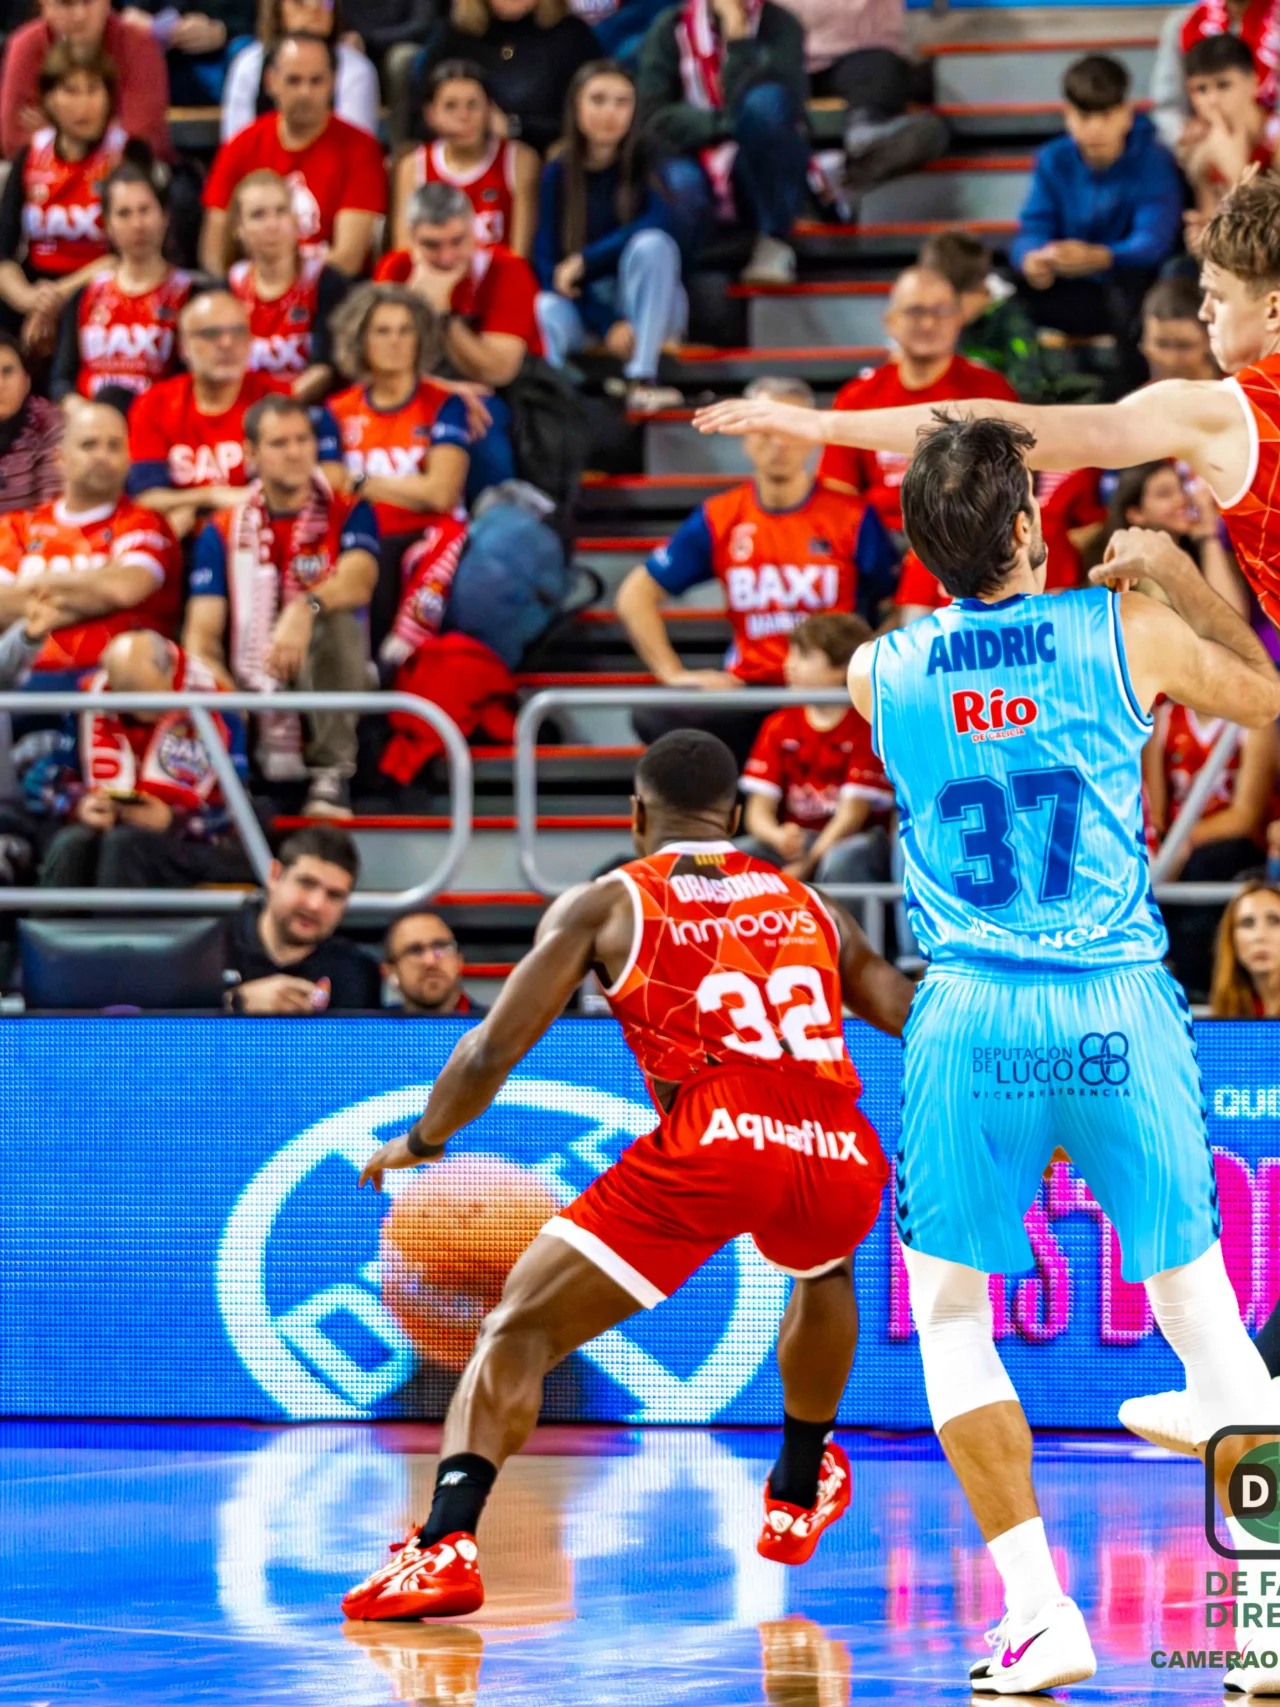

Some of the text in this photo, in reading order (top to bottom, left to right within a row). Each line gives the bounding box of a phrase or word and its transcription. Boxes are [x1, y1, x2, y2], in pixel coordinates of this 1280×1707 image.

[727, 564, 839, 611] BAXI
[926, 622, 1057, 676] ANDRIC
[952, 689, 1038, 734] Río
[972, 728, 1026, 743] DE GALICIA
[935, 765, 1086, 912] 37
[669, 871, 790, 903] OBASOHAN
[670, 910, 817, 946] inmoovs
[696, 965, 844, 1061] 32
[973, 1046, 1072, 1060] DEPUTACÓN
[973, 1059, 1073, 1084] DE LUGO
[972, 1088, 1132, 1100] VICEPRESIDENCIA
[700, 1108, 868, 1165] Aquaflix
